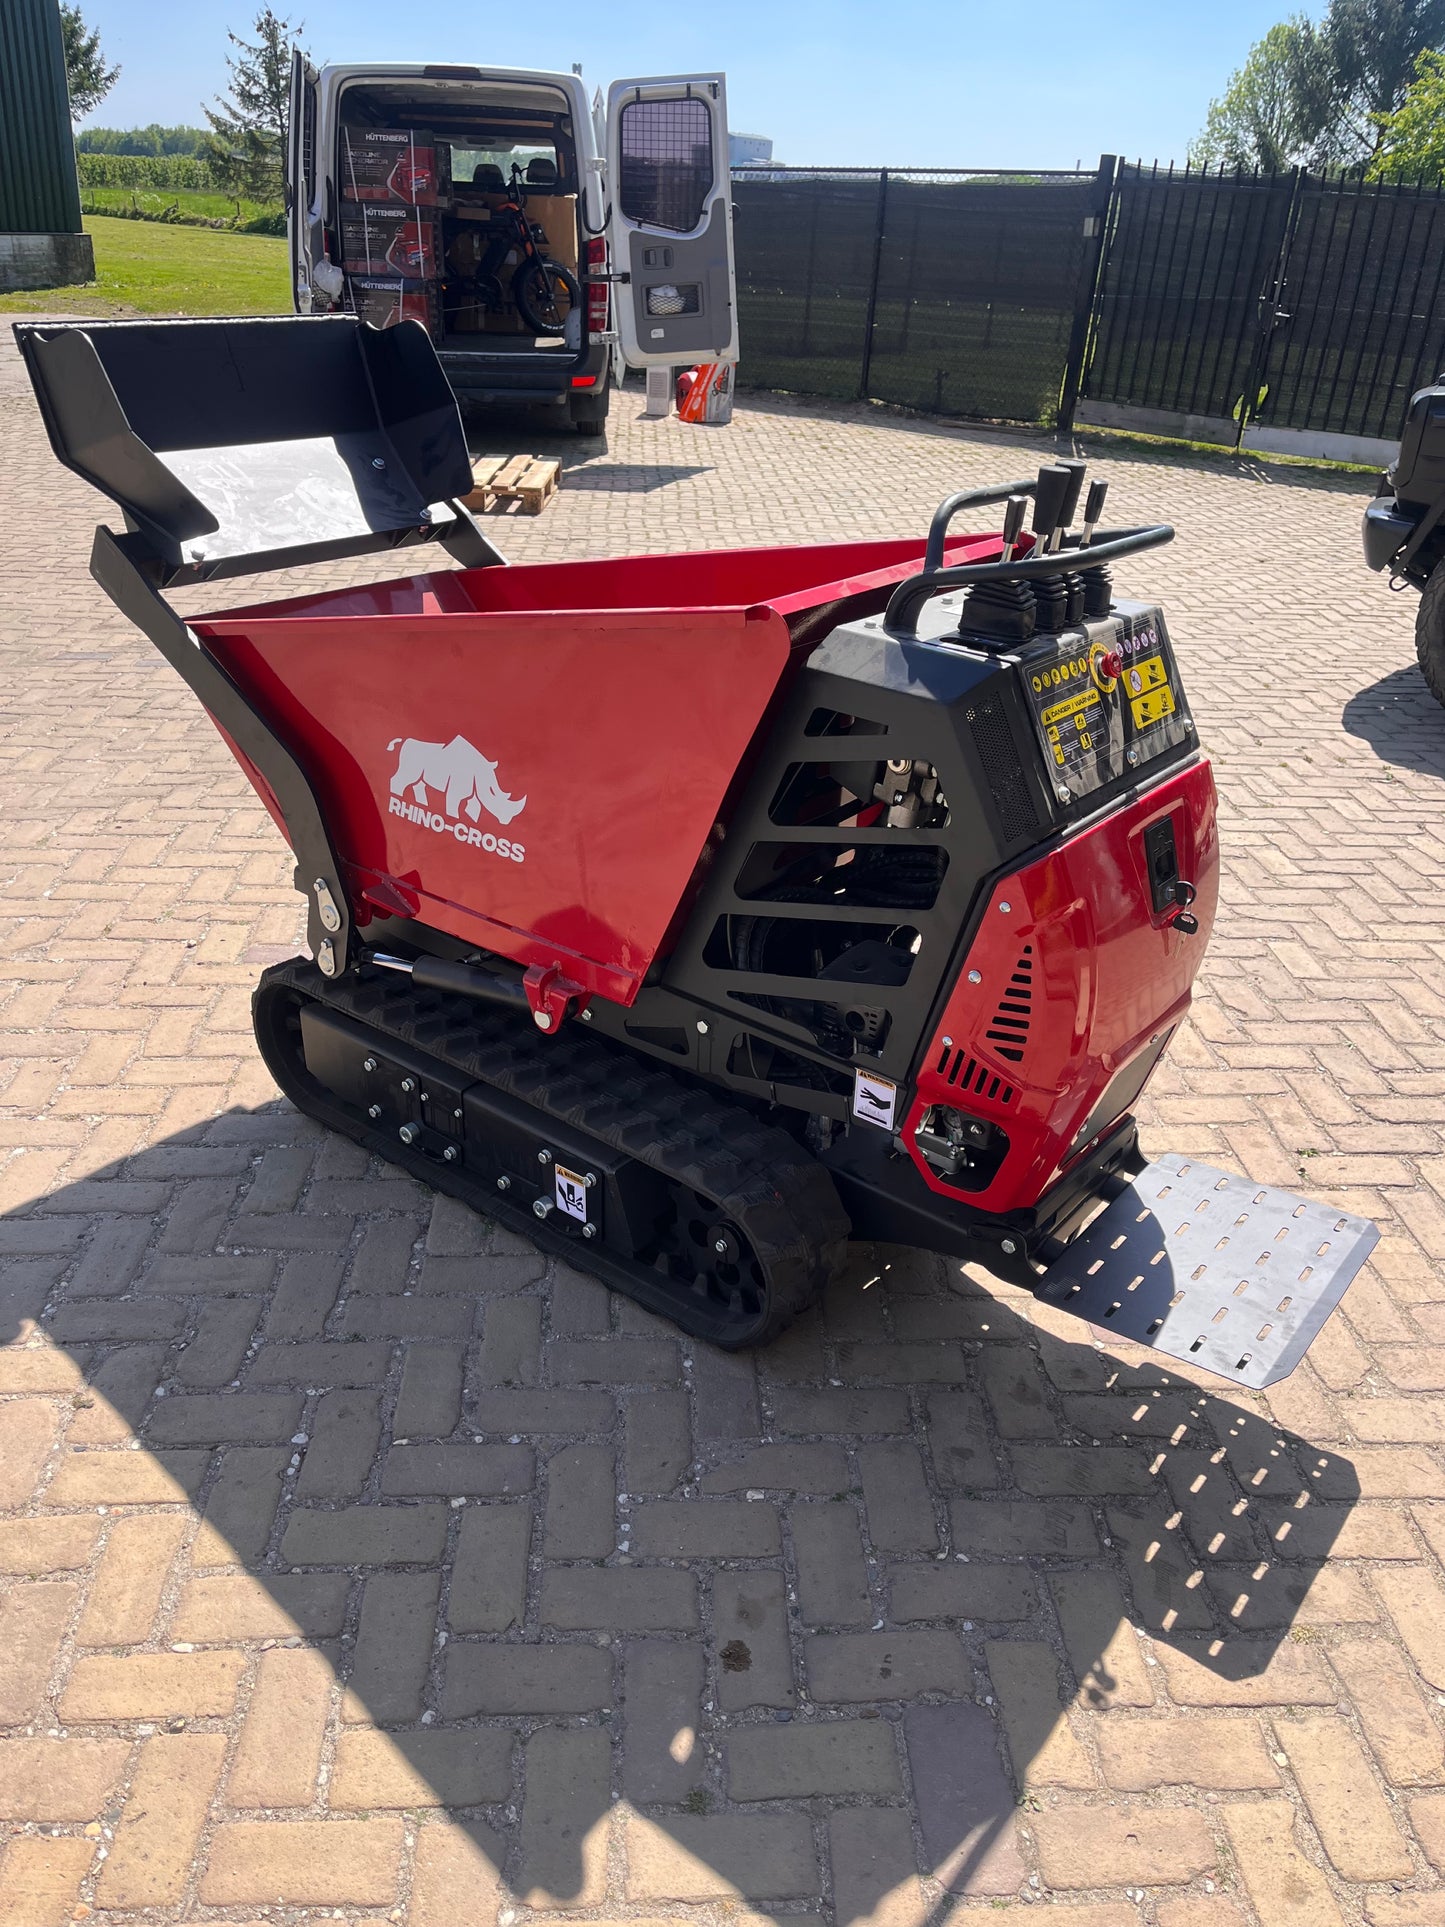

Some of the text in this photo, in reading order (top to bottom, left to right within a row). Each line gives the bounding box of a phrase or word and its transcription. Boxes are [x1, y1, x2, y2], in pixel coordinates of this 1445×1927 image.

[365, 133, 408, 142] HÜTTENBERG
[1051, 704, 1071, 717] DANGER
[1075, 693, 1096, 707] WARNING
[388, 796, 526, 863] RHINO-CROSS
